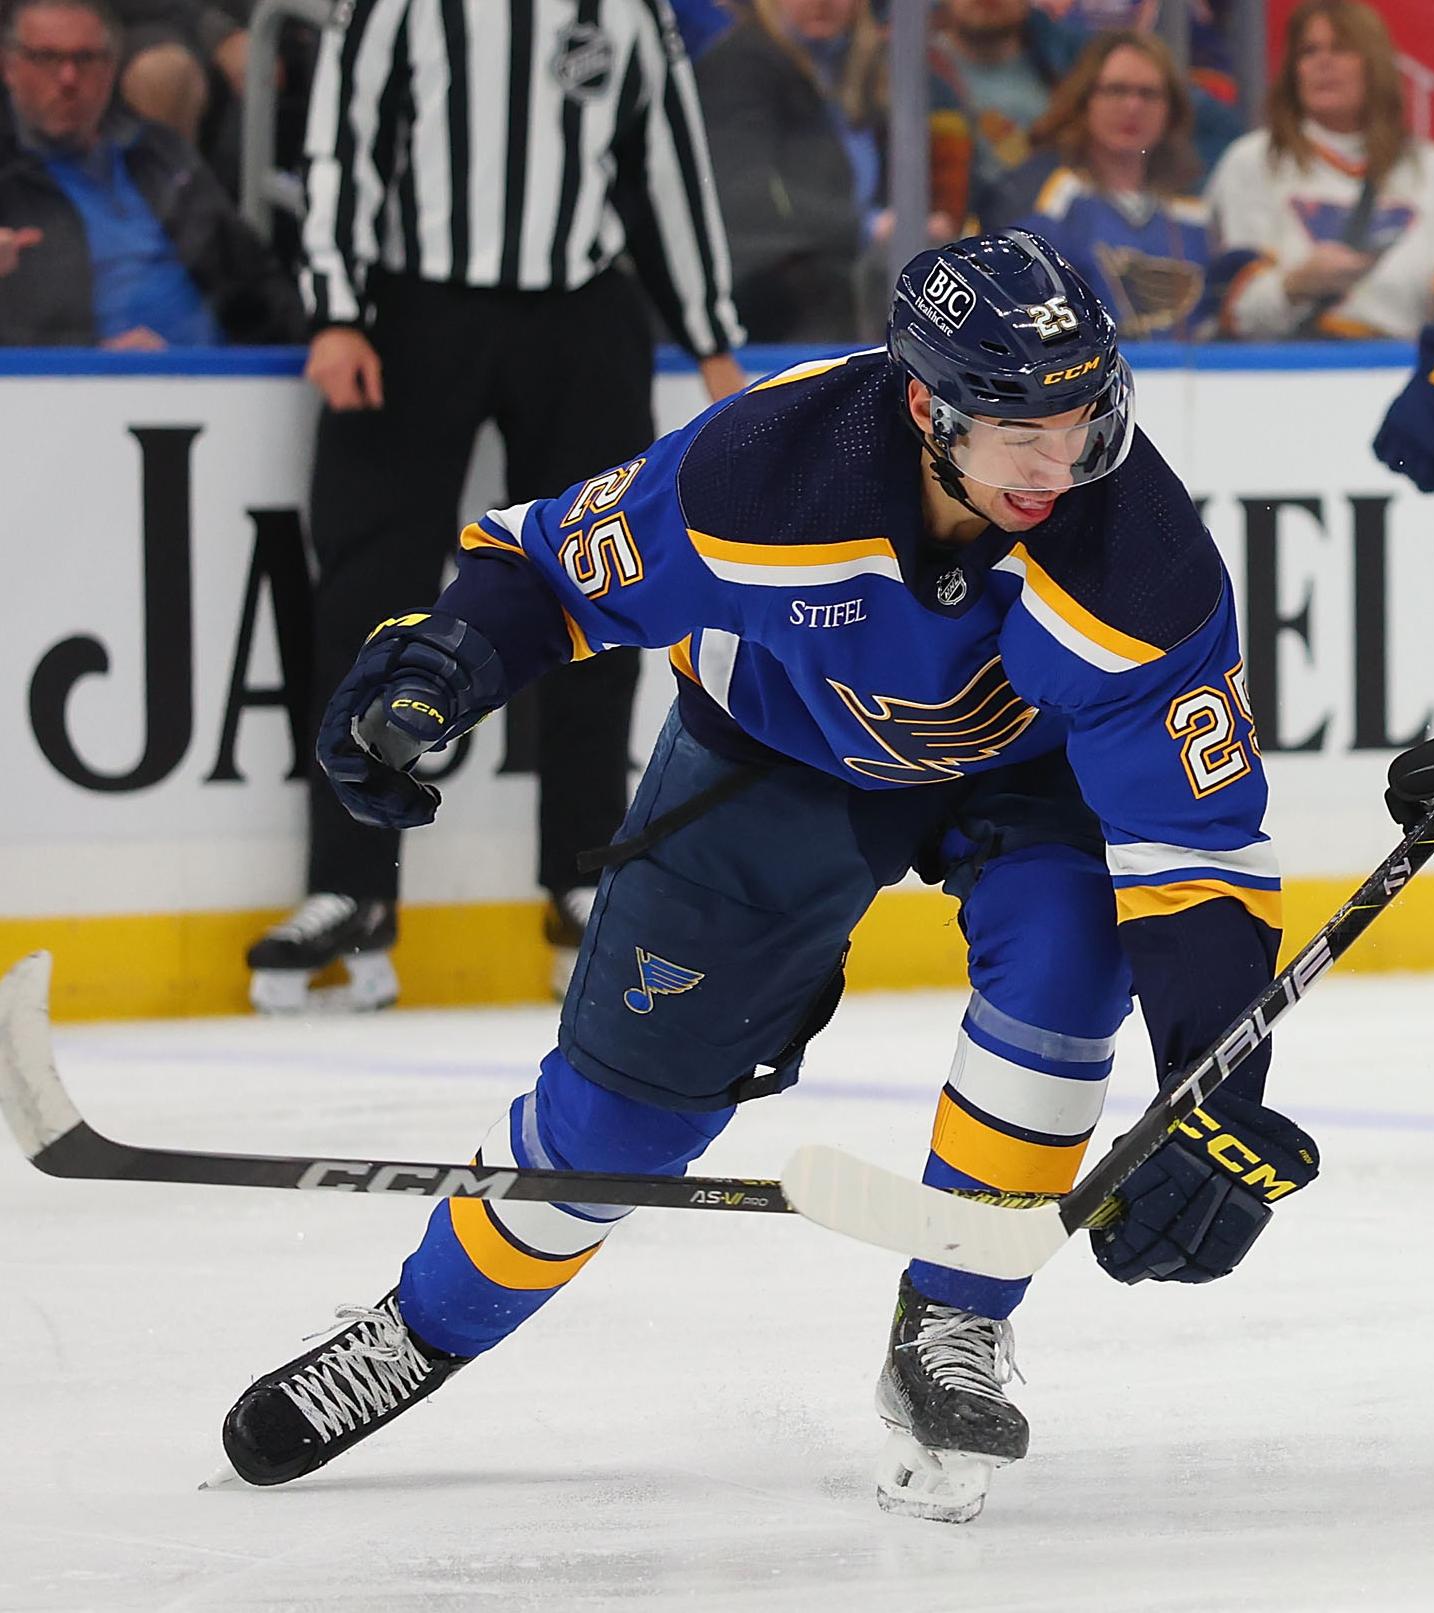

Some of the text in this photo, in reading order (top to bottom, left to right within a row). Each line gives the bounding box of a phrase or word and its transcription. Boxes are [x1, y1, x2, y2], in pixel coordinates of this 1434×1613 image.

[926, 269, 971, 317] BJC
[914, 295, 954, 338] HealthCare
[1027, 296, 1078, 340] 25
[1042, 355, 1101, 385] CCM
[559, 458, 646, 600] 25
[789, 598, 867, 628] STIFEL
[391, 698, 445, 725] CCM
[1170, 934, 1335, 1107] TRUE
[1178, 1107, 1298, 1201] CCM
[296, 1160, 520, 1200] CCM
[743, 1196, 769, 1207] PRO
